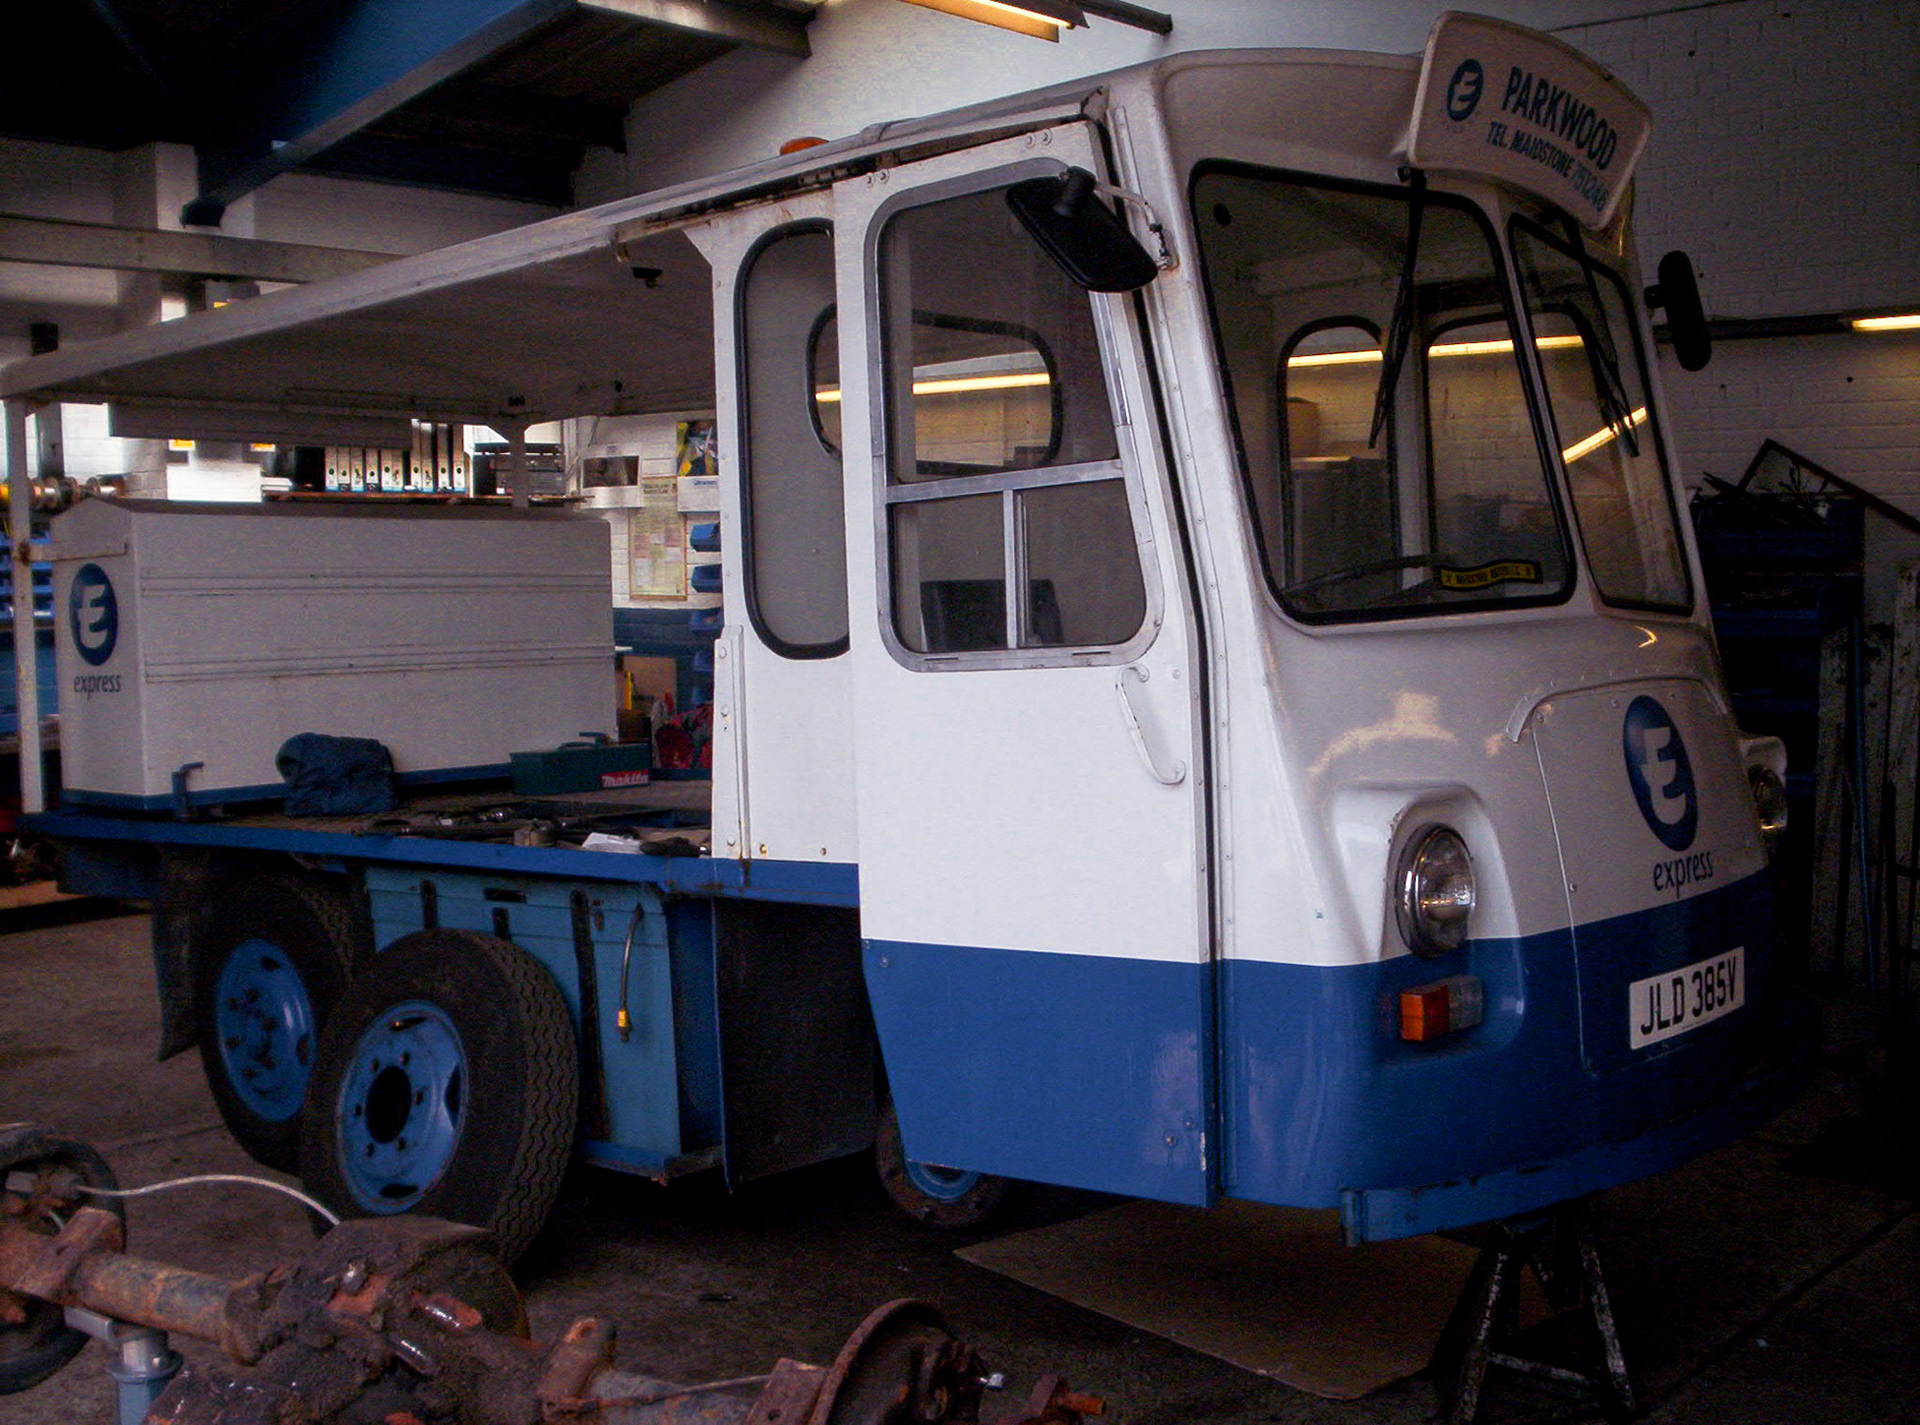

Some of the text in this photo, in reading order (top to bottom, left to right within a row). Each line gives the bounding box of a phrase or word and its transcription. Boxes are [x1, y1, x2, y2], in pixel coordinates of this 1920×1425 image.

[1501, 66, 1618, 170] PARKWOOD
[1511, 129, 1575, 179] MAIDSTONE
[74, 673, 121, 701] express
[1653, 850, 1714, 899] express
[1640, 956, 1738, 1035] JLD 385V
